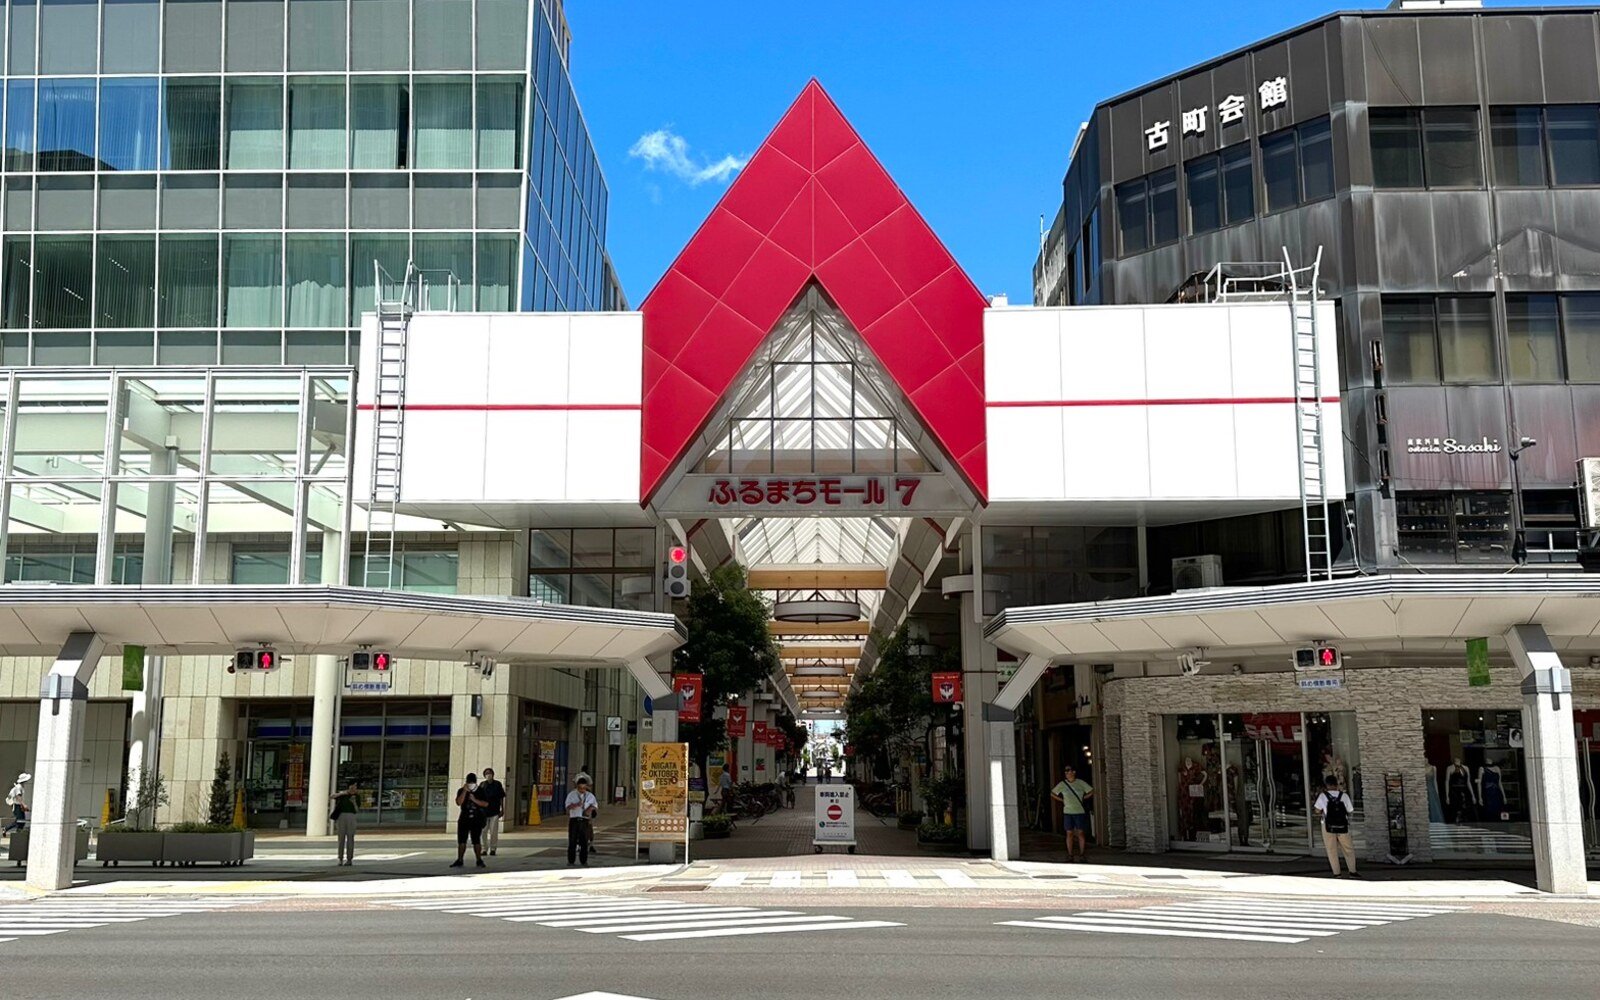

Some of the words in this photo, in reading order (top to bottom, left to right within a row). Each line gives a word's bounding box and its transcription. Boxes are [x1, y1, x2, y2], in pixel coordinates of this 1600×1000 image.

[1145, 76, 1287, 151] 古町会館
[1443, 436, 1502, 453] Sasaki
[651, 761, 678, 770] NIIGATA
[648, 770, 679, 778] OKTOBER
